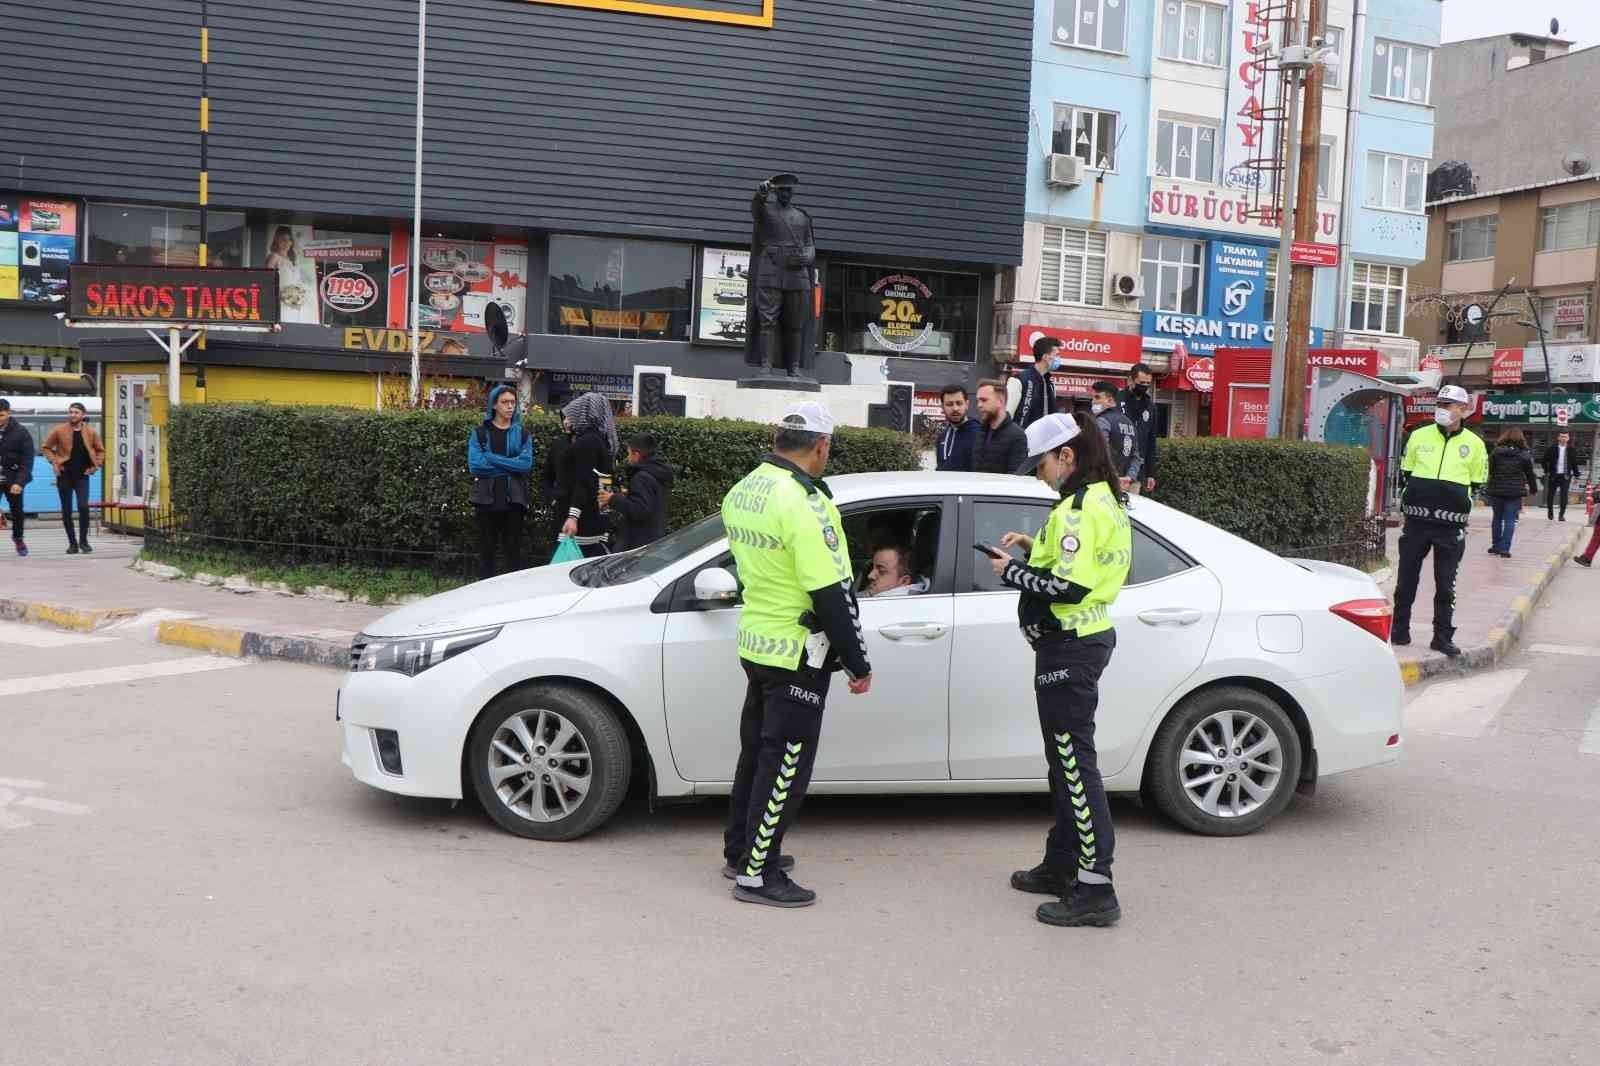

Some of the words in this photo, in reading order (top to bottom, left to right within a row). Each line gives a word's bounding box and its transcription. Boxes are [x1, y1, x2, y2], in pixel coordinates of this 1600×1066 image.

[1151, 185, 1249, 224] SÜRÜCÜ
[1215, 253, 1264, 269] İLKYARDIM
[1222, 245, 1257, 257] TRAKYA
[86, 283, 175, 318] SAROS
[181, 283, 261, 320] TAKSİ
[880, 299, 914, 321] 20
[1155, 314, 1222, 337] KEŞAN
[1226, 321, 1259, 340] TIP
[1059, 338, 1111, 354] odafone
[1482, 400, 1528, 419] Peynir
